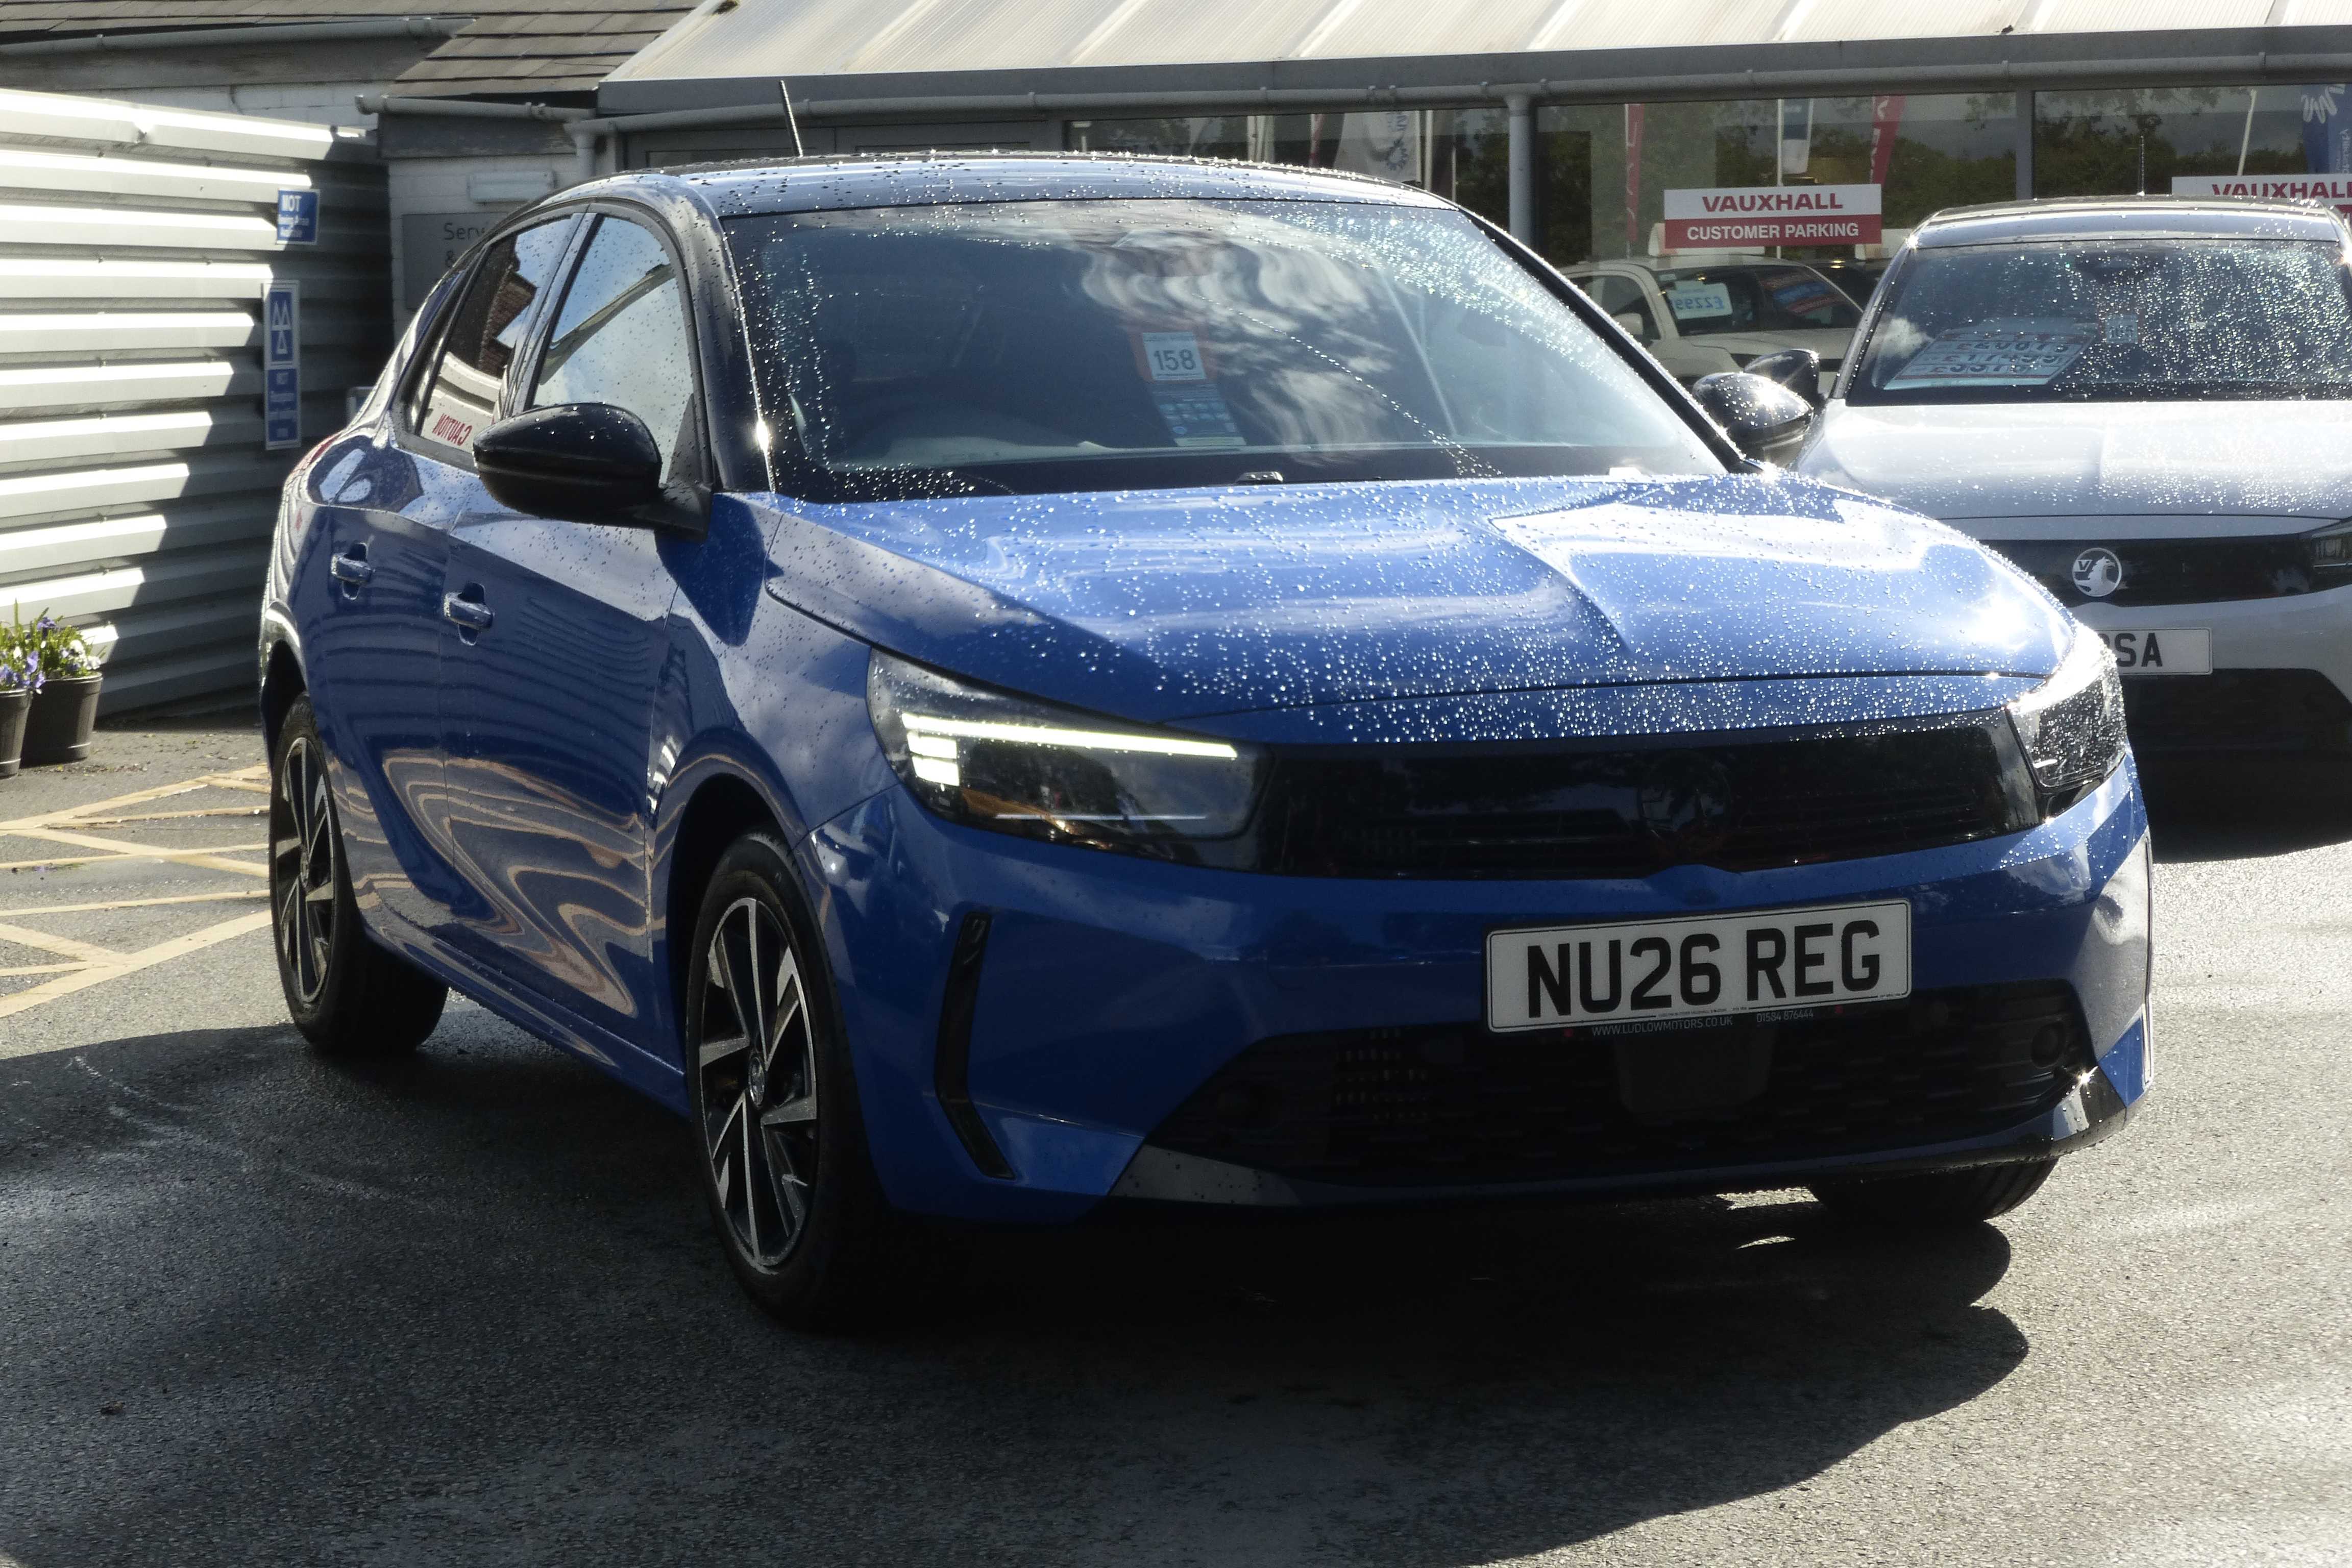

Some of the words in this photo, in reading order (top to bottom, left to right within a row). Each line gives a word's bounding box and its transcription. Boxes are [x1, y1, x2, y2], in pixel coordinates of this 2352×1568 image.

[2212, 181, 2352, 200] VAUXHAL
[1702, 193, 1844, 212] VAUXHALL
[1687, 225, 1780, 240] CUSTOMER
[1785, 222, 1859, 238] PARKING
[1154, 349, 1196, 371] 158
[2098, 633, 2163, 667] SA
[1528, 933, 1722, 1019] NU26
[1746, 919, 1880, 1001] REG
[1756, 1012, 1781, 1022] 01584
